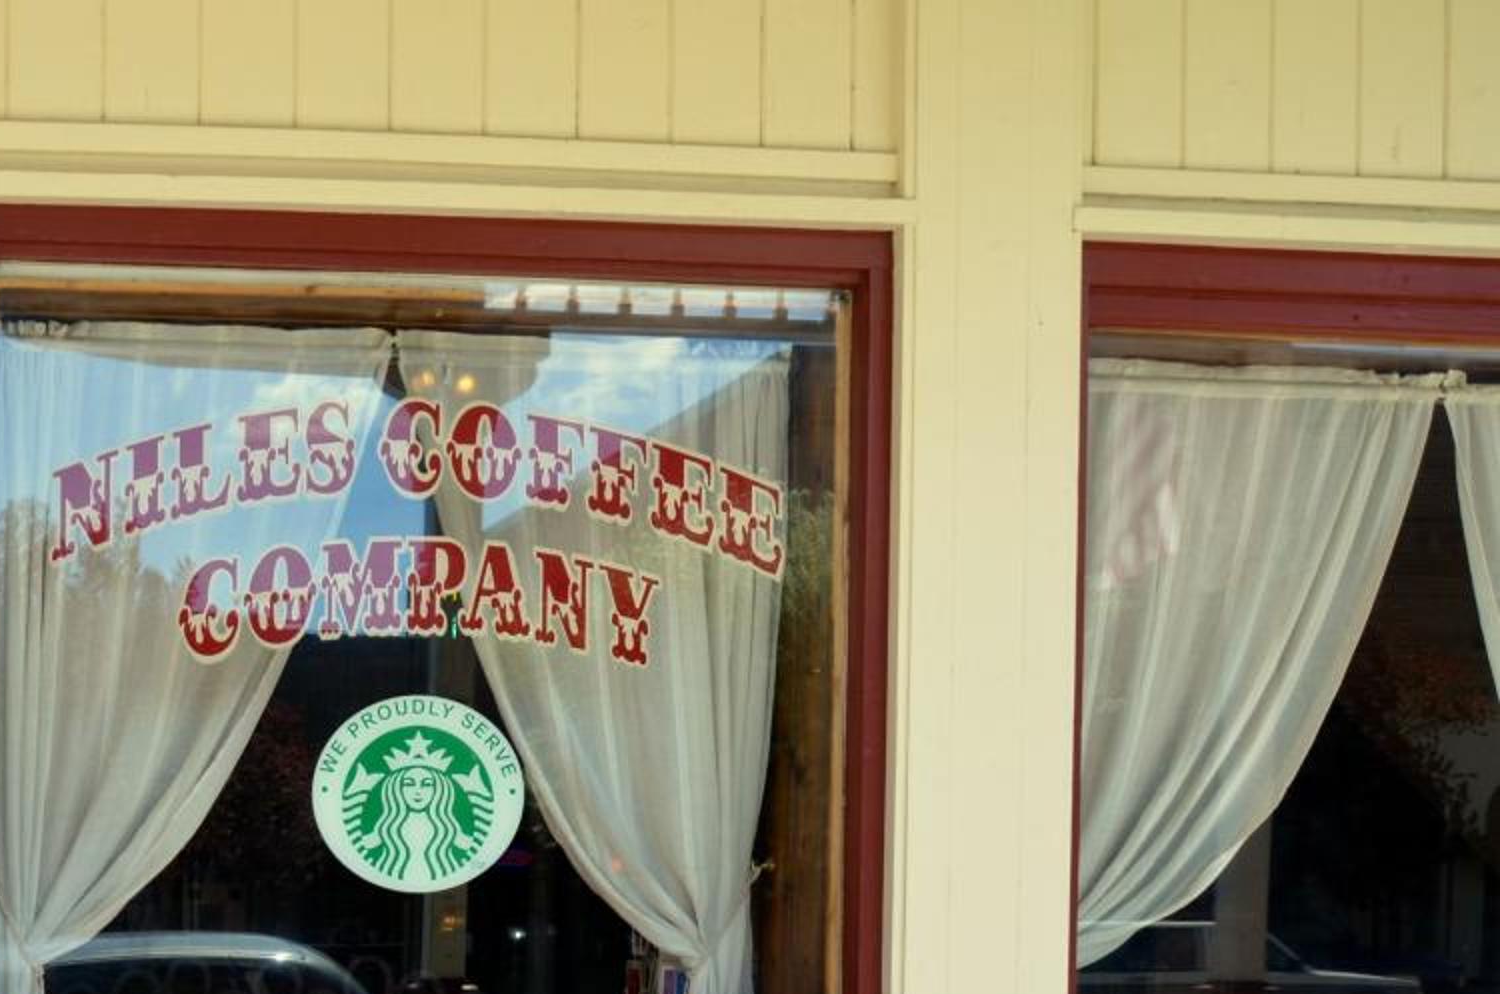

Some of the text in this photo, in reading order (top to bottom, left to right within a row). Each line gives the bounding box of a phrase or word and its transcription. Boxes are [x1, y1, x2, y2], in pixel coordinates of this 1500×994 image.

[50, 399, 786, 578] NILES COFFEE
[177, 535, 662, 667] COMPANY
[320, 699, 517, 778] WE PROUDLY SERVE
